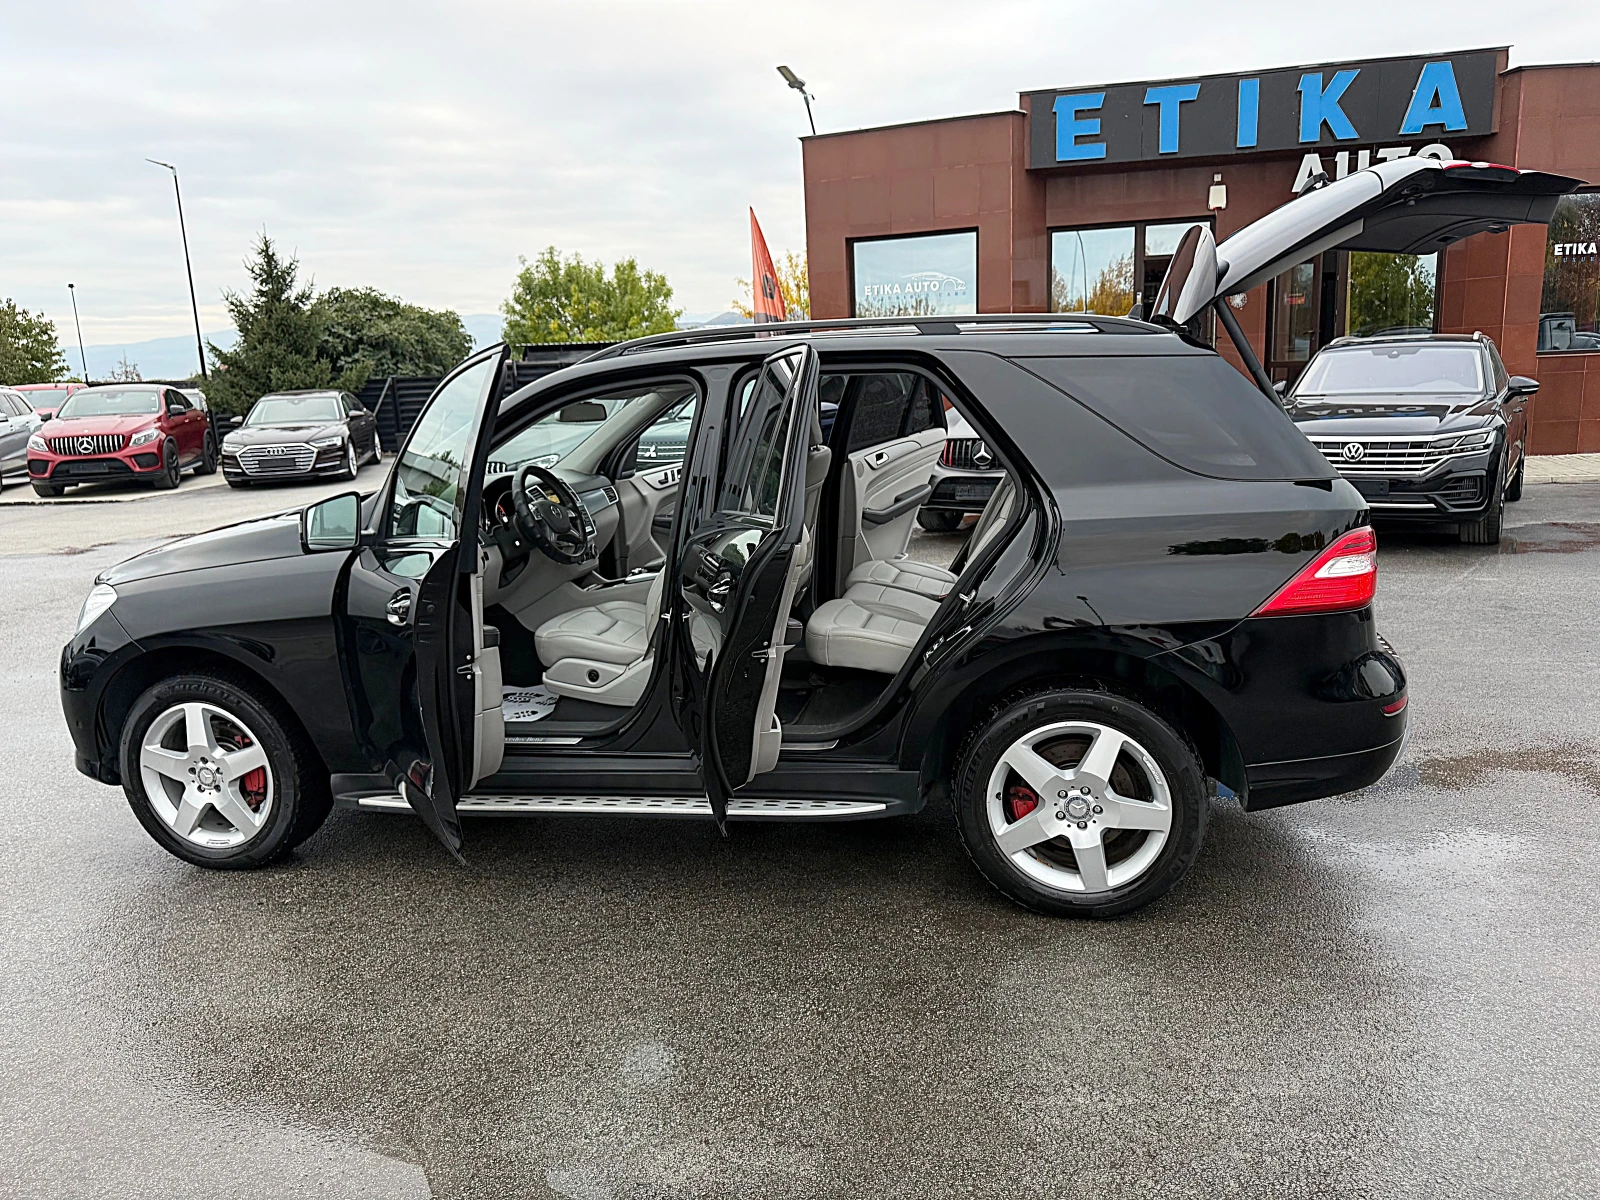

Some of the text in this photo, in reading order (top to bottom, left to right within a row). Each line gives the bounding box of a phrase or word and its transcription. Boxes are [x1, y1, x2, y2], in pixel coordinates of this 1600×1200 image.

[1052, 60, 1468, 161] ETIKA
[1553, 242, 1598, 256] ETIKA
[864, 281, 940, 296] ETIKA AUTO
